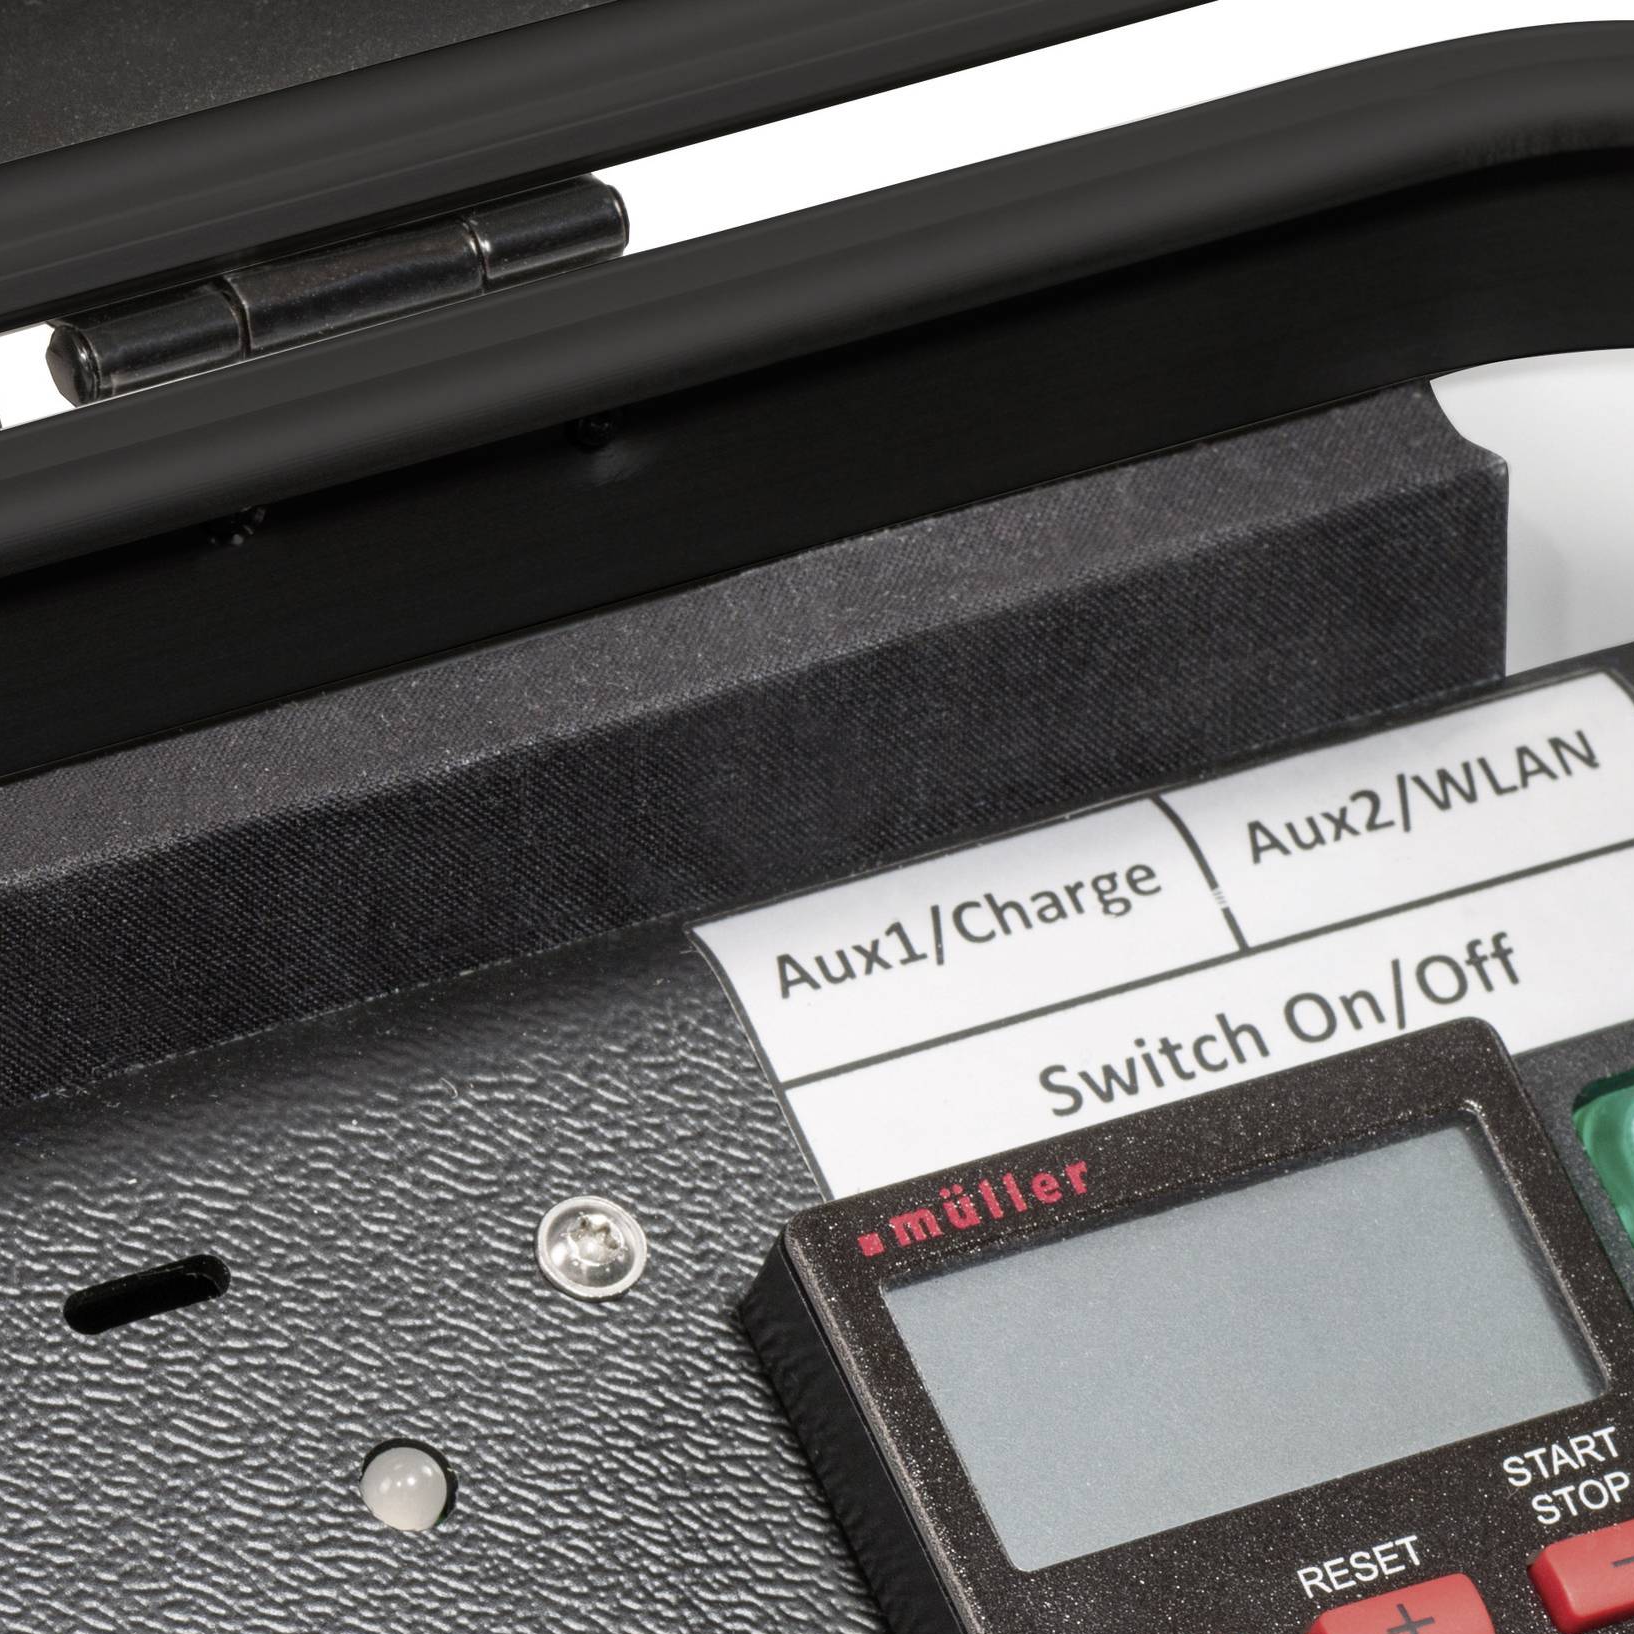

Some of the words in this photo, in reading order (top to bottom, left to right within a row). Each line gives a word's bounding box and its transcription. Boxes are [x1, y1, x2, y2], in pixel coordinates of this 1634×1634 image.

[1247, 730, 1600, 864] Aux2/WLAN
[776, 864, 1162, 999] Aux1/Charge
[1039, 1014, 1270, 1117] Switch
[1284, 931, 1521, 1050] On/Off
[889, 1160, 1088, 1247] müller
[1502, 1426, 1620, 1488] START
[1531, 1471, 1631, 1526] STOP
[1296, 1534, 1420, 1599] RESET
